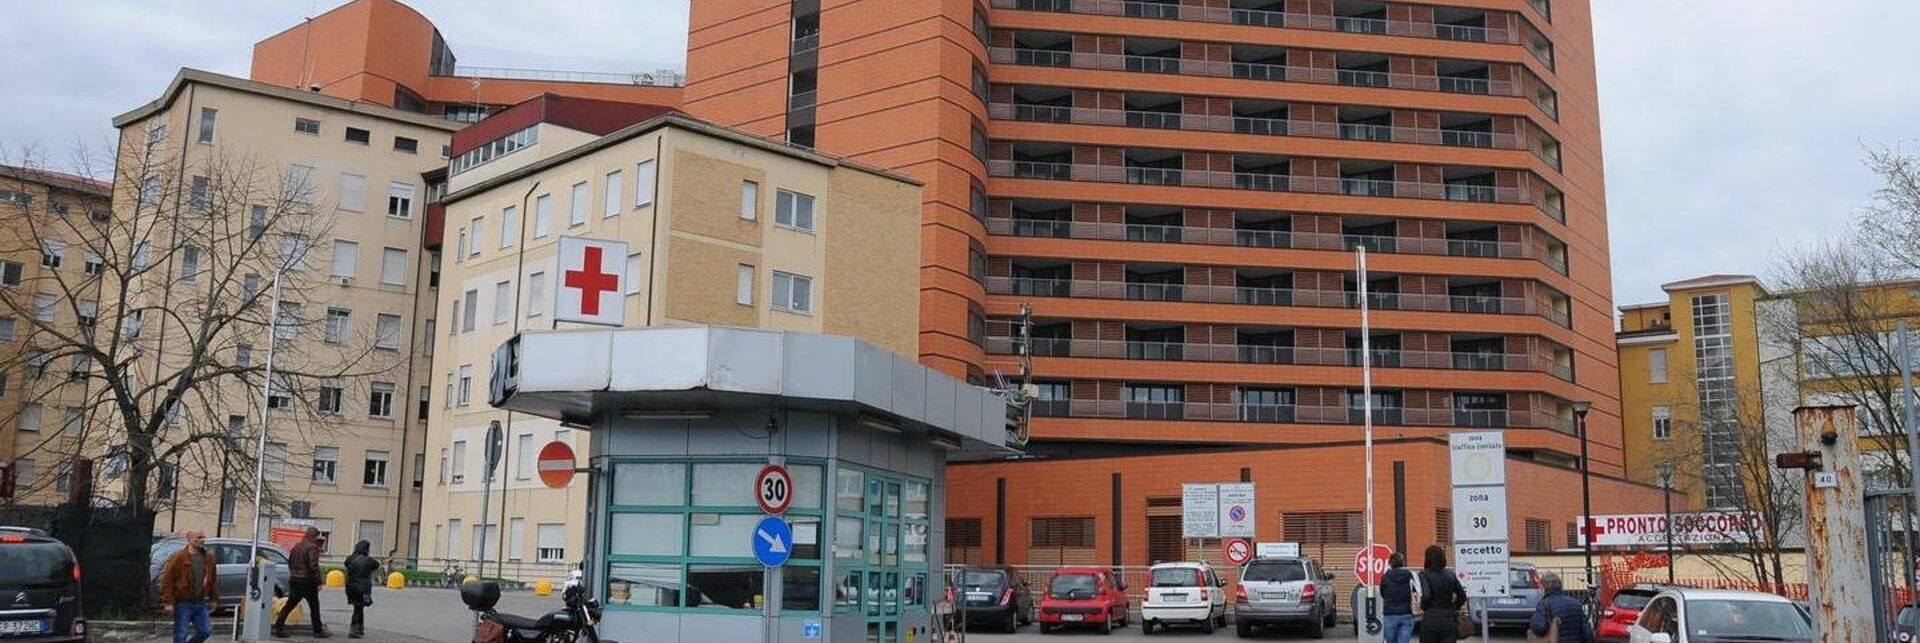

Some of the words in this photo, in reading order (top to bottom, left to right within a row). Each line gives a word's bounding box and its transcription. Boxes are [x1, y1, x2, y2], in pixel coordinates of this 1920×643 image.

[1819, 475, 1832, 484] 40
[764, 478, 785, 501] 30
[1469, 494, 1489, 502] zona
[1473, 517, 1488, 529] 30
[1607, 516, 1667, 535] PRONTO
[1676, 513, 1761, 534] SOCCORSO
[1460, 545, 1502, 555] eccetto
